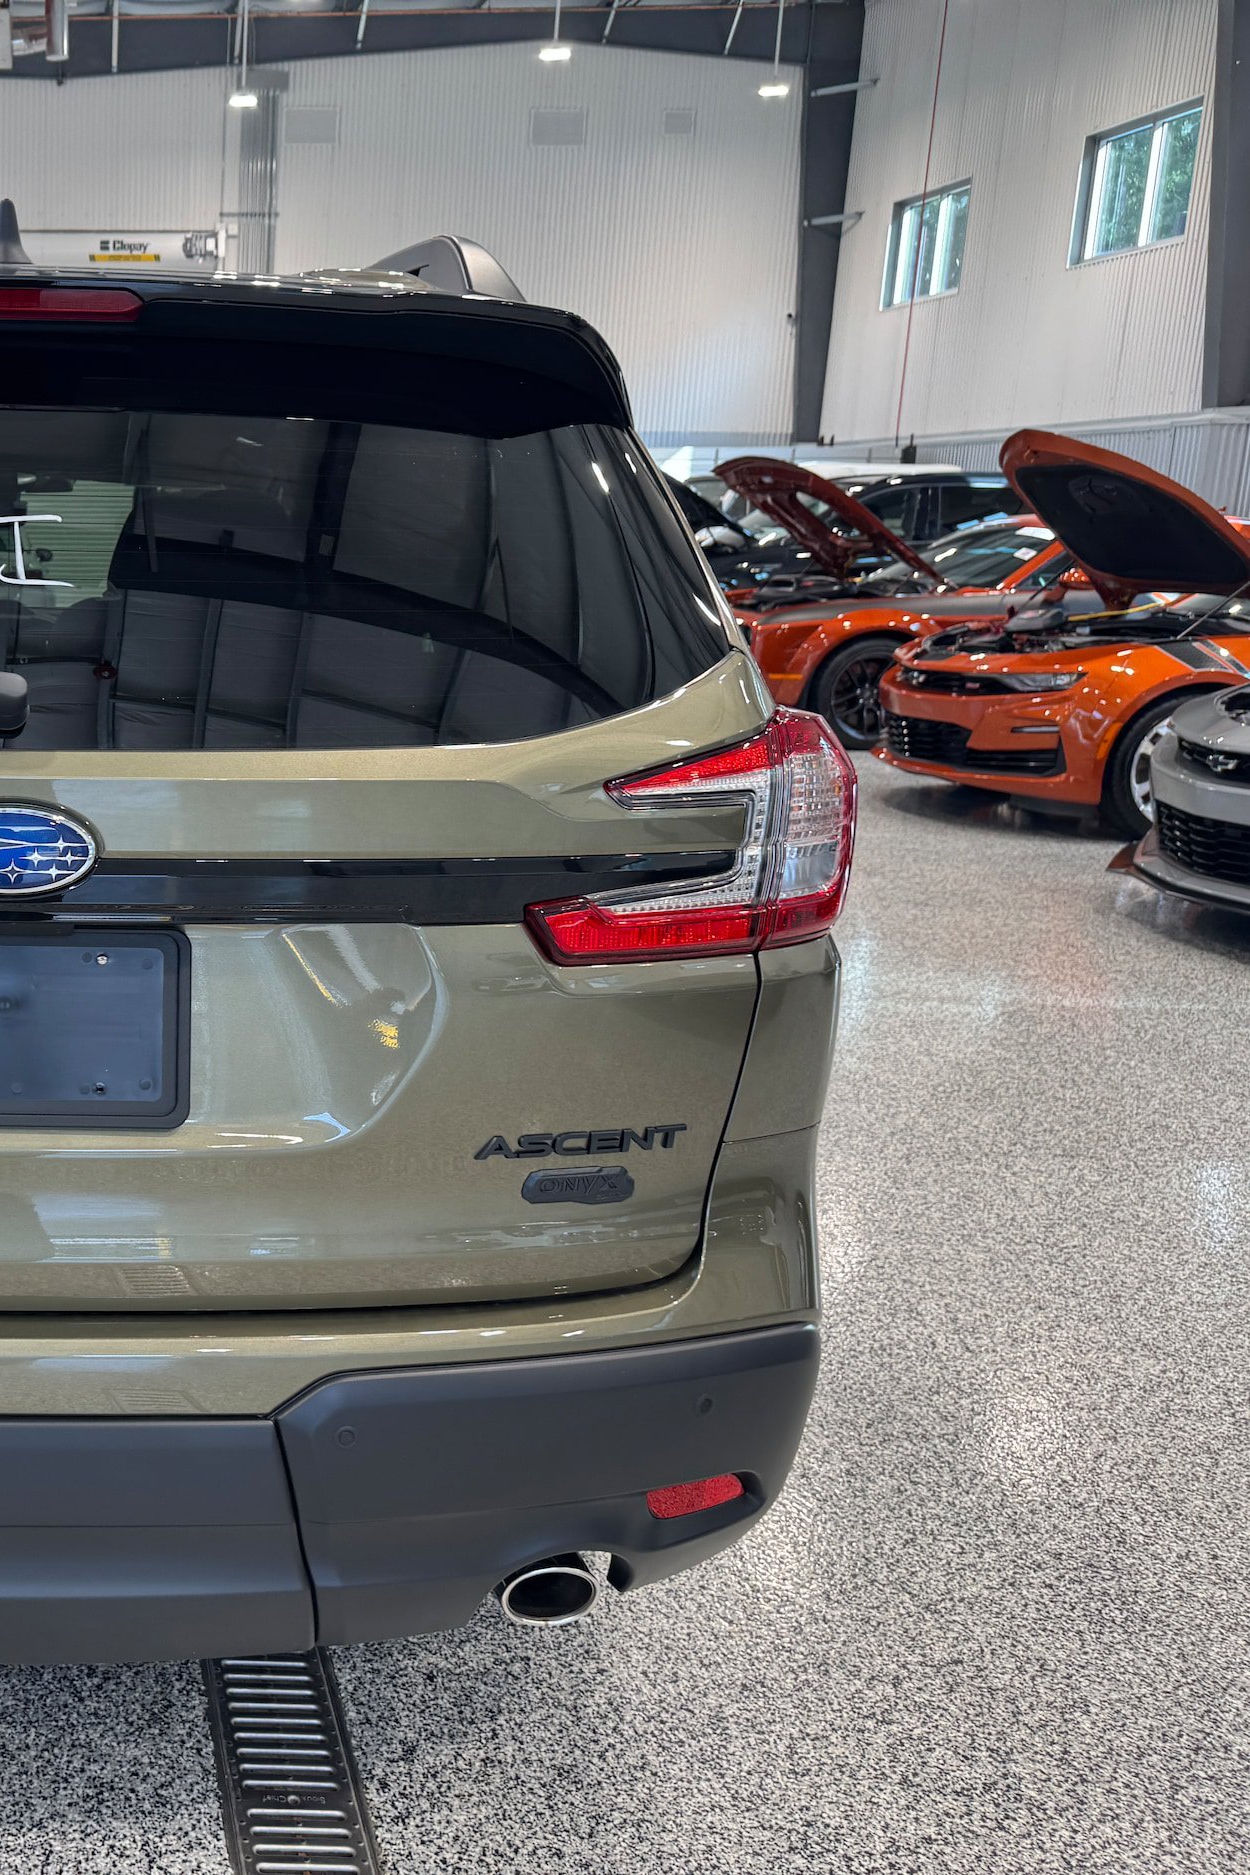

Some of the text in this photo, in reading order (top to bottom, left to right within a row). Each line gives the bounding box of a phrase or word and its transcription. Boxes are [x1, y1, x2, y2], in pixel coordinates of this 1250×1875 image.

[113, 240, 149, 253] Clopay
[473, 1123, 688, 1161] ASCENT
[538, 1173, 619, 1195] ONYX
